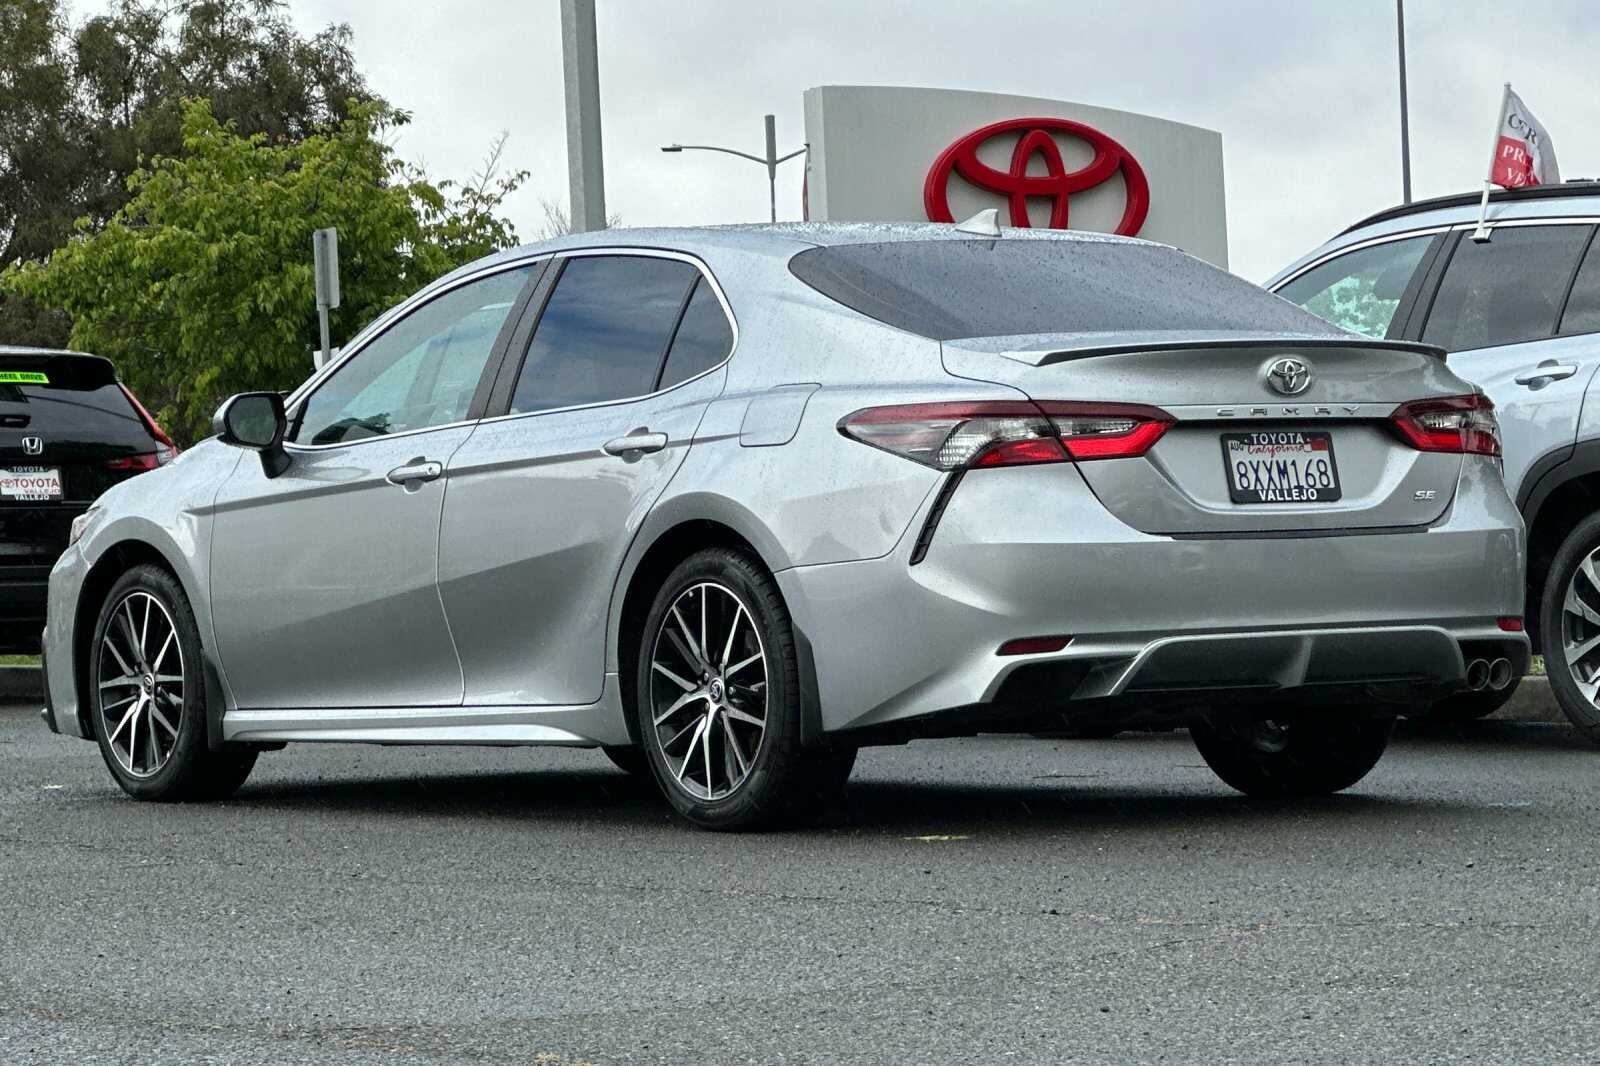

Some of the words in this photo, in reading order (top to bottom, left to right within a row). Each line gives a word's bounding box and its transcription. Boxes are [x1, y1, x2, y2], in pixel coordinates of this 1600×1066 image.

[1216, 407, 1360, 416] CAMRY
[1251, 433, 1305, 445] TOYOTA
[1236, 459, 1331, 489] 8XXM168
[14, 479, 59, 488] TOYOTA
[1258, 489, 1318, 501] VALLEJO
[1414, 490, 1436, 500] SE
